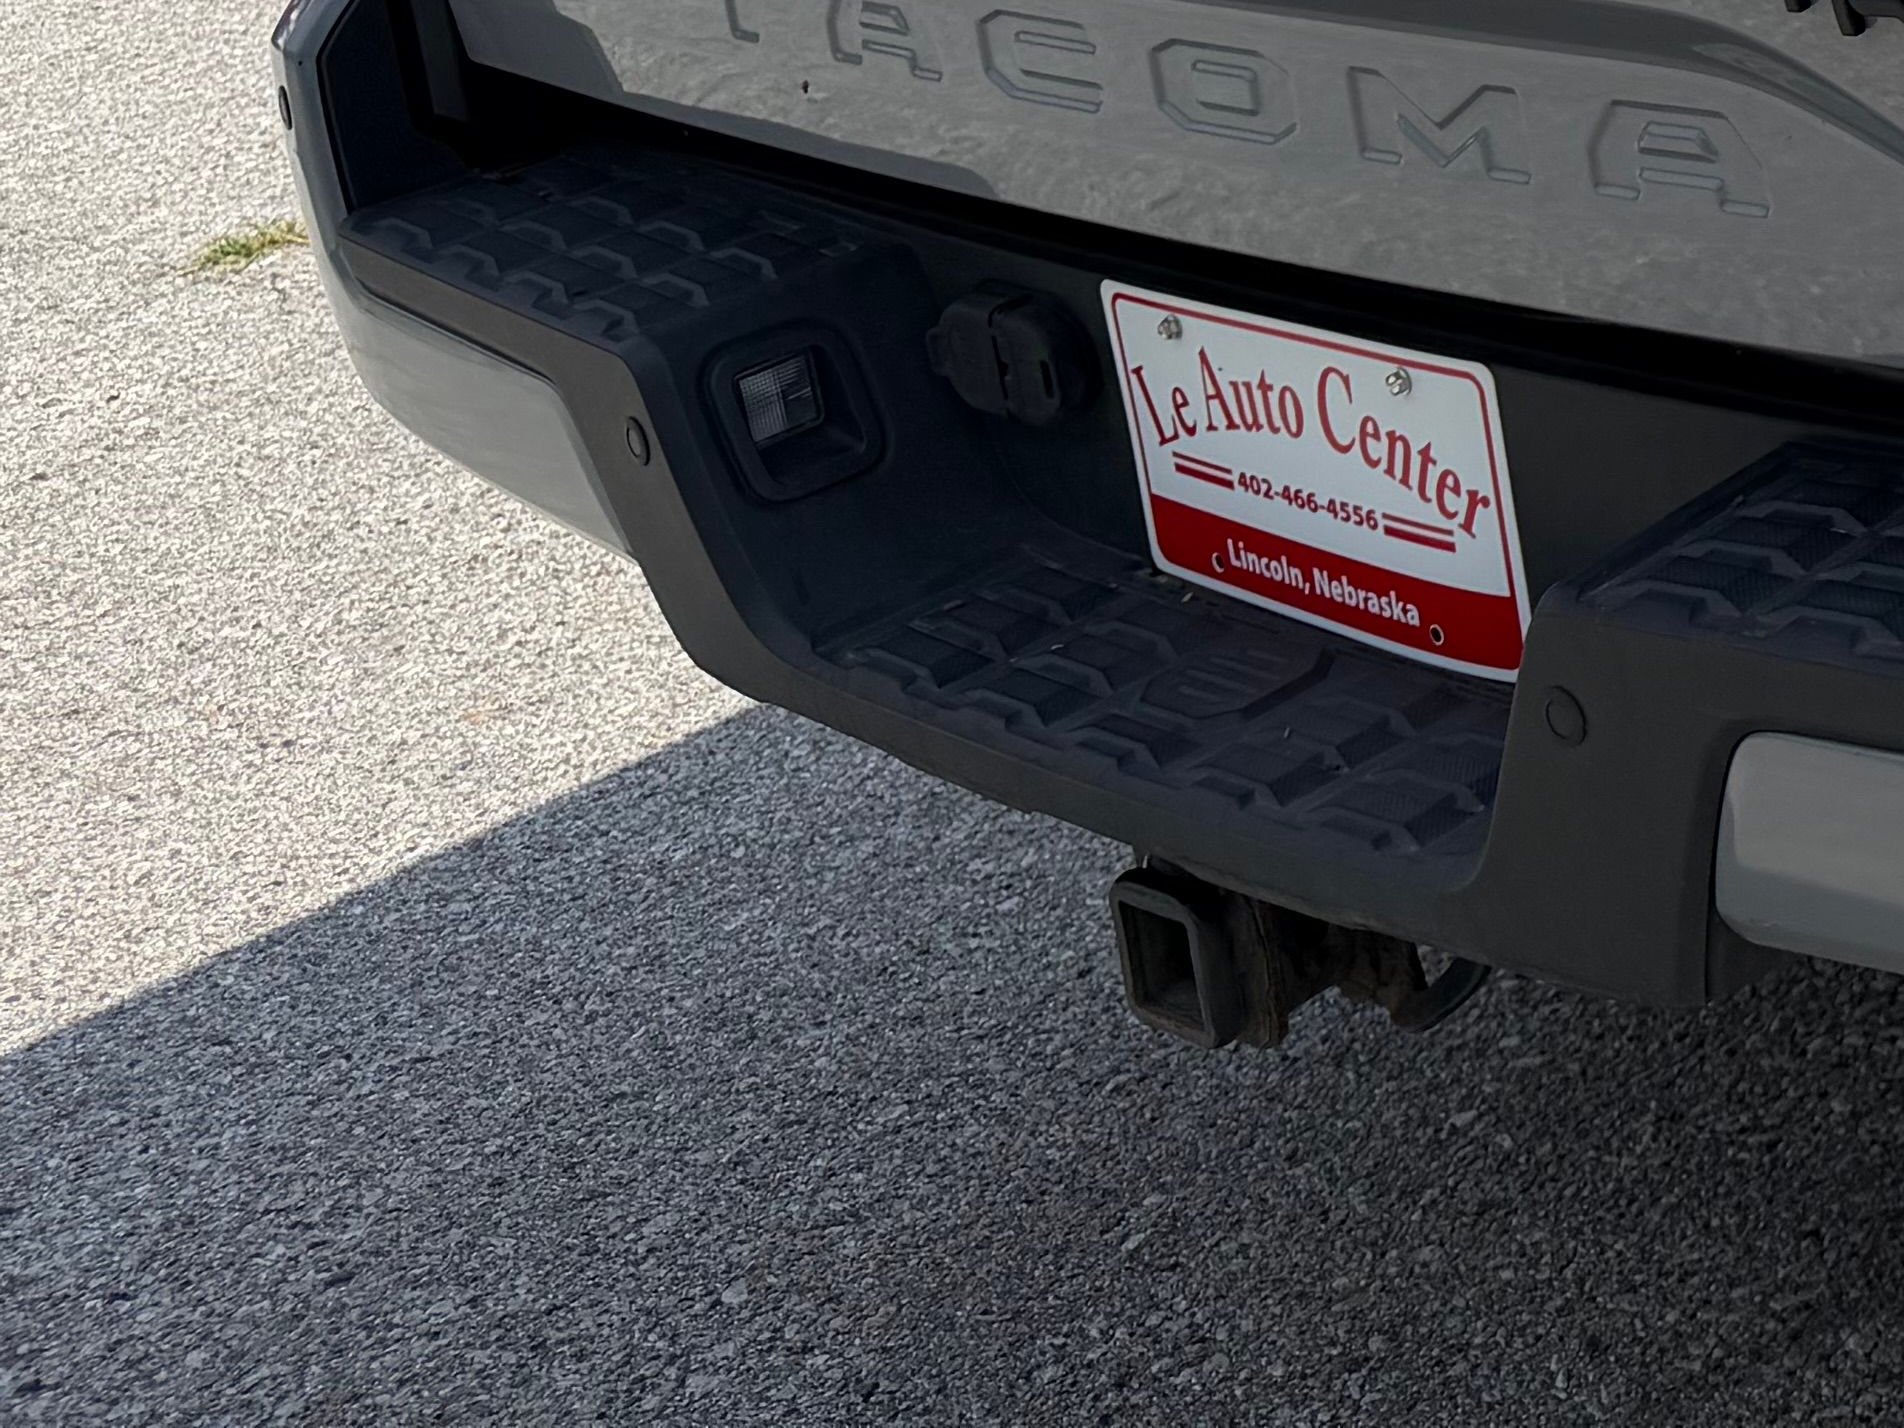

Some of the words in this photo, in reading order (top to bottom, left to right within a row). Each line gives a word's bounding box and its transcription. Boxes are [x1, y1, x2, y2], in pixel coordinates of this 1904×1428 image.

[1130, 364, 1198, 448] Le
[1198, 345, 1304, 440] Auto
[1316, 365, 1492, 540] Center
[1236, 470, 1380, 532] 402-466-4556
[1226, 537, 1313, 597] Lincoln,
[1312, 571, 1422, 628] Nebraska
